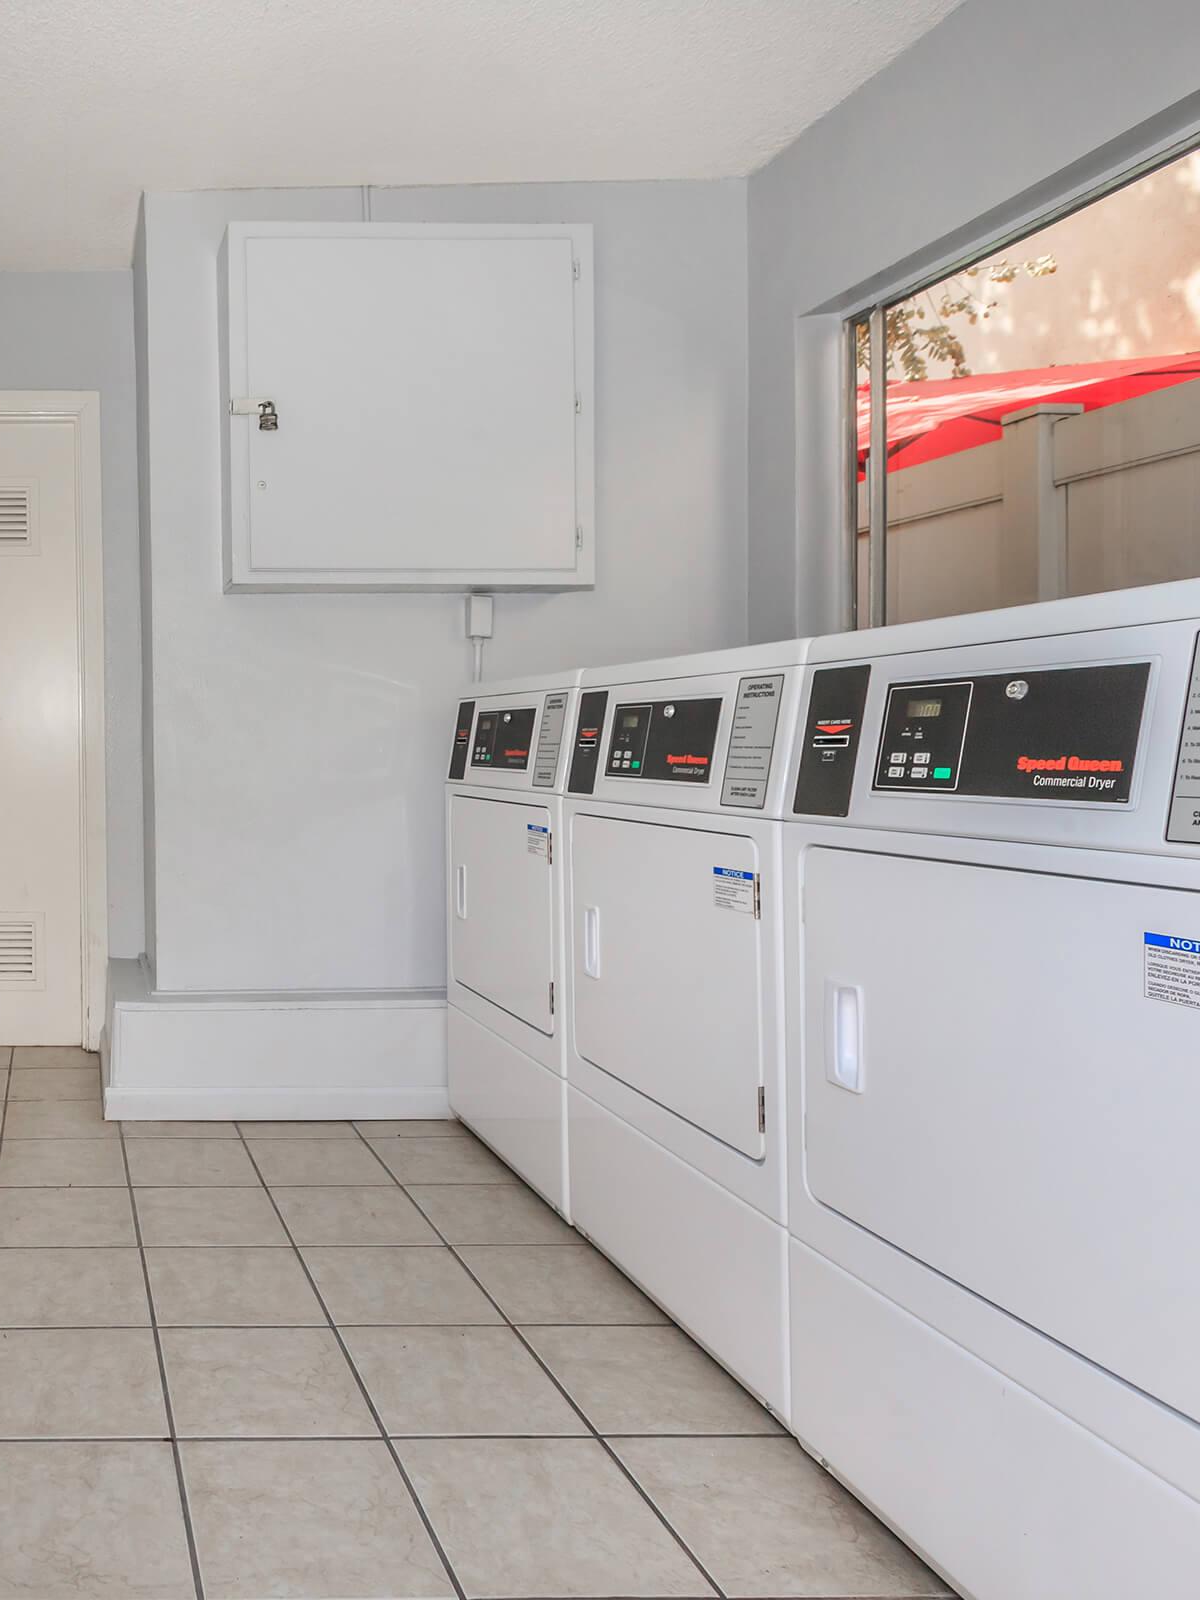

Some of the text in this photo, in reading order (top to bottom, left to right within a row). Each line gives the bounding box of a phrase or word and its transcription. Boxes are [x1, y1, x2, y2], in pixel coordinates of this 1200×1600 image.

[1017, 756, 1122, 773] Speed Queen
[1033, 775, 1116, 790] Commercial Dryer
